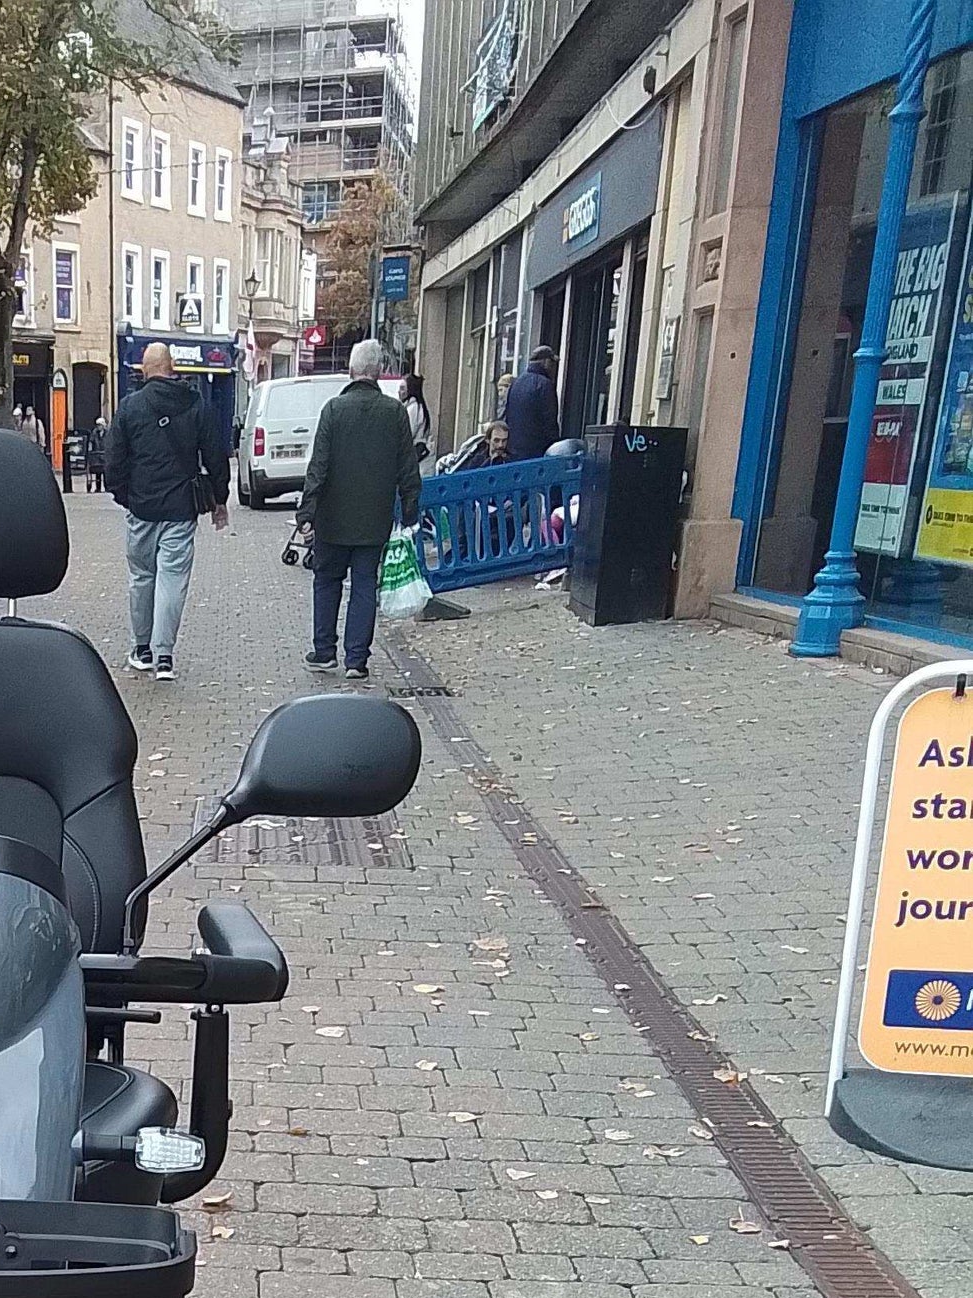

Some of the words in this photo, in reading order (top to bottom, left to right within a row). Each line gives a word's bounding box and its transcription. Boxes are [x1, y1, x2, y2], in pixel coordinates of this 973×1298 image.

[894, 247, 920, 296] THE
[913, 242, 947, 293] BIG
[887, 343, 918, 360] NGLAND
[882, 384, 907, 400] WALES
[912, 792, 973, 820] sta
[893, 890, 973, 928] jour
[894, 1041, 973, 1058] www.m
